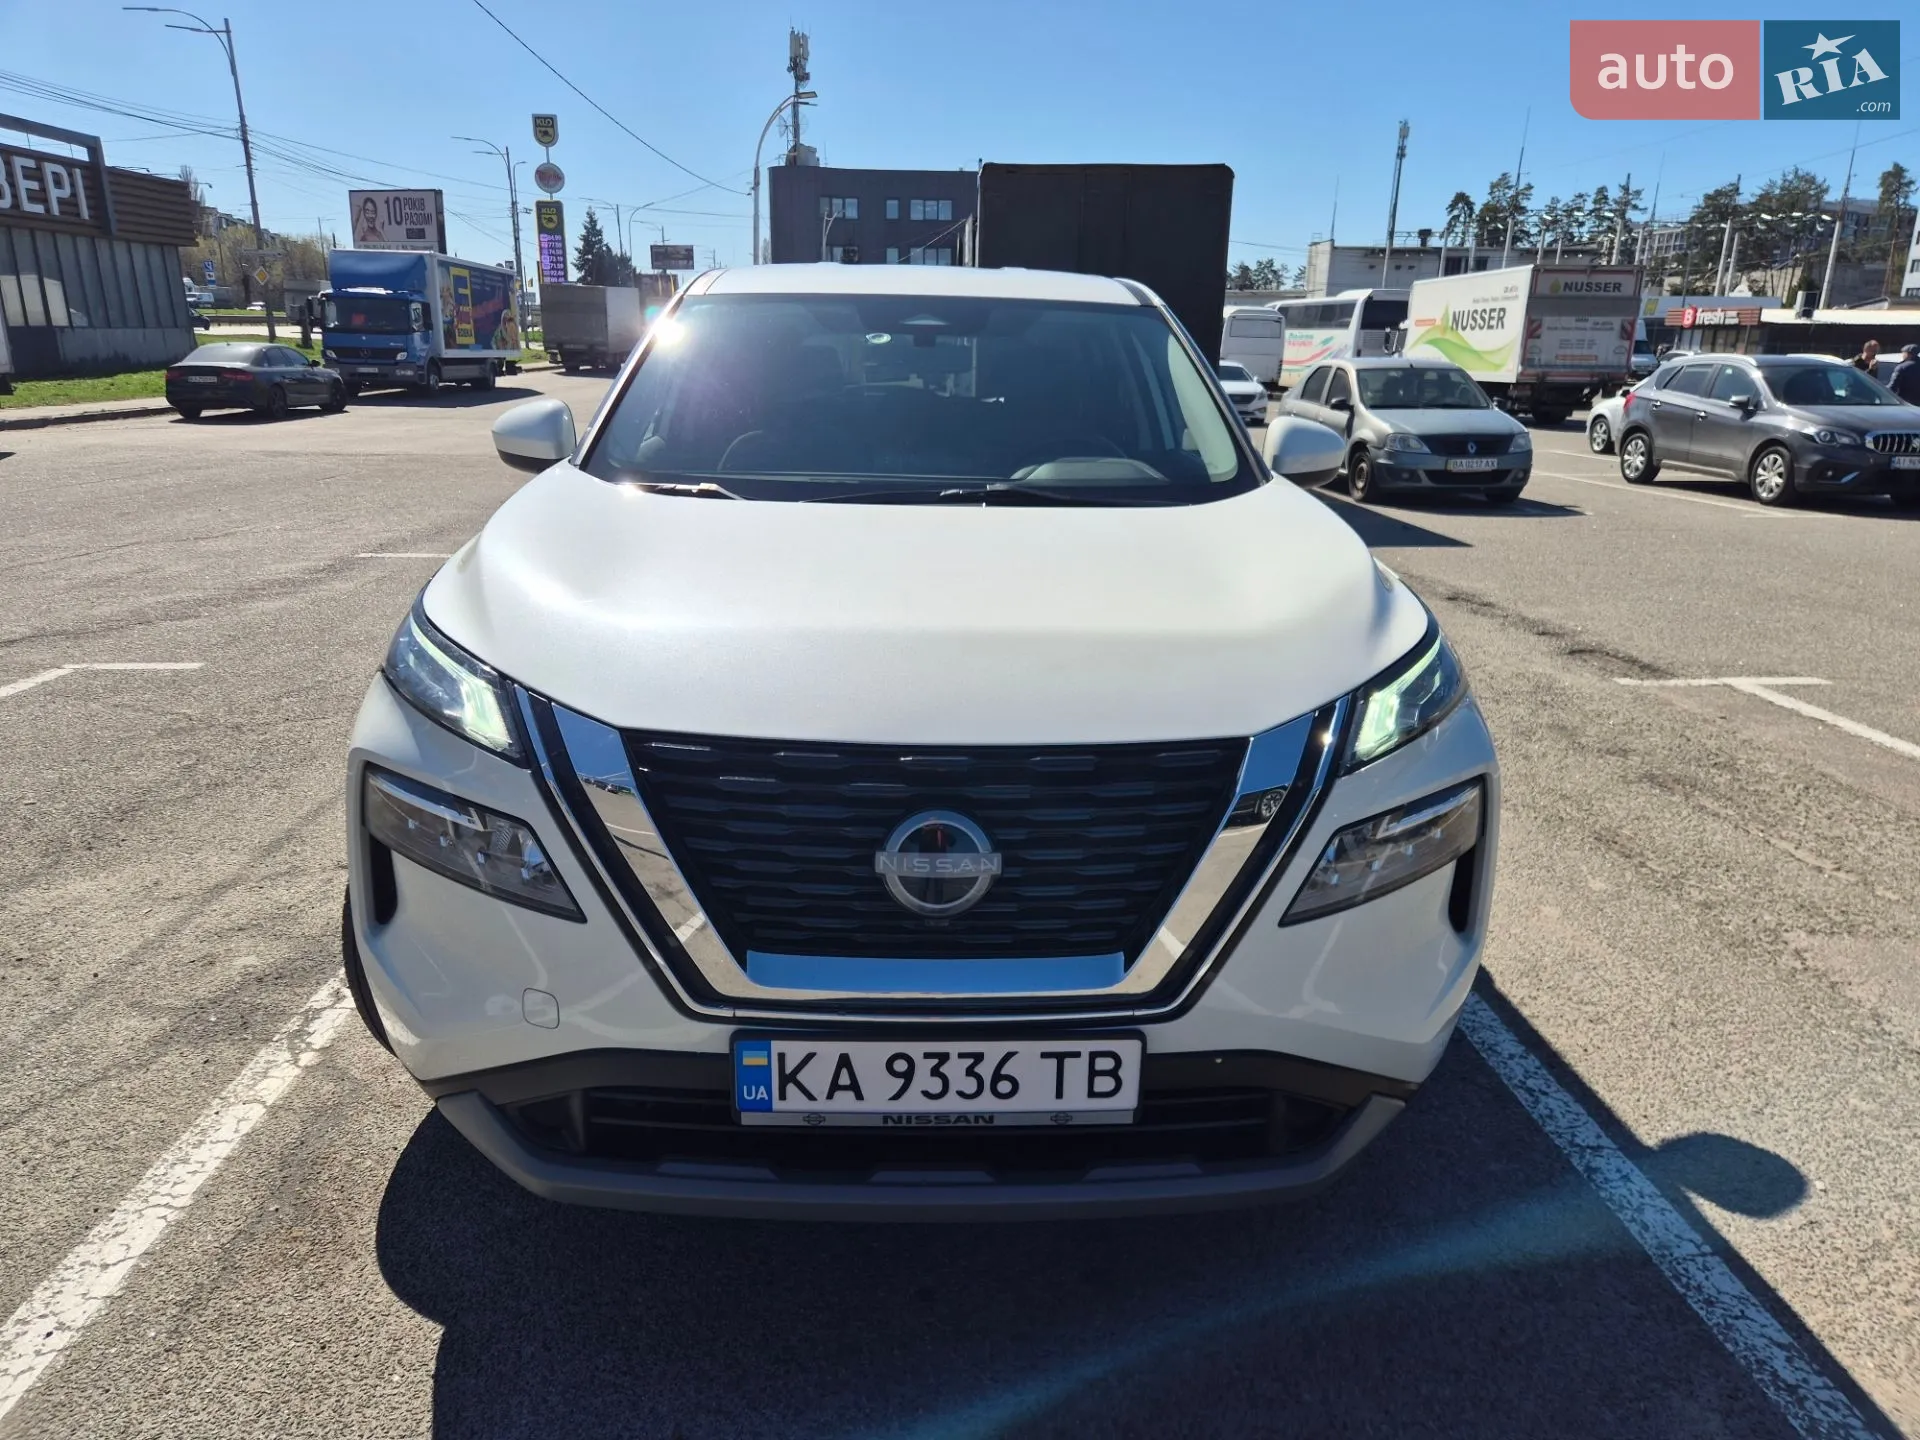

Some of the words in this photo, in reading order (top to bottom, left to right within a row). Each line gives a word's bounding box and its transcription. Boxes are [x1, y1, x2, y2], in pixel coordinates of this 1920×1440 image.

[384, 196, 404, 226] 10
[403, 197, 426, 212] РОКІВ
[1563, 281, 1622, 293] NUSSER
[1450, 307, 1507, 332] NUSSER
[1695, 308, 1725, 325] fresh
[879, 855, 998, 873] NISSAN
[776, 1051, 865, 1101] KA
[885, 1051, 1020, 1101] 9336
[1040, 1050, 1123, 1100] TB
[743, 1085, 769, 1100] UA
[881, 1114, 995, 1126] NISSAN
